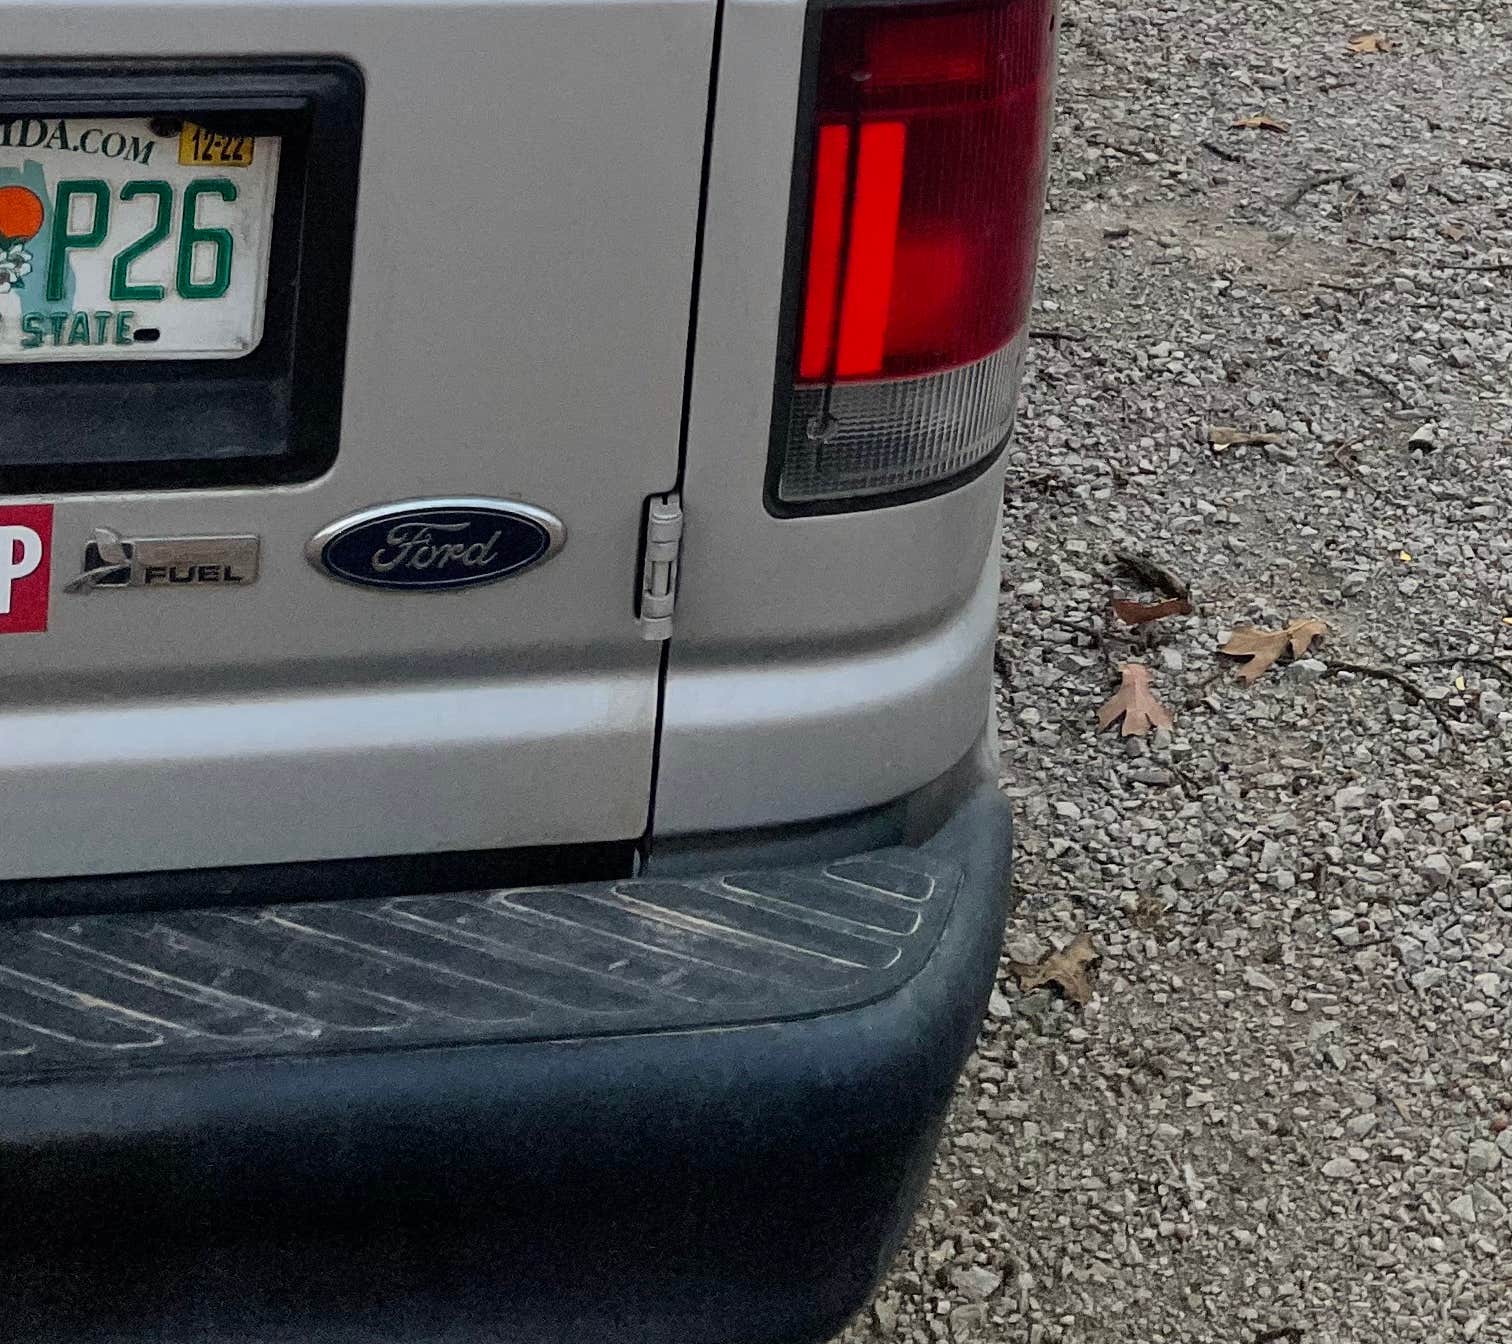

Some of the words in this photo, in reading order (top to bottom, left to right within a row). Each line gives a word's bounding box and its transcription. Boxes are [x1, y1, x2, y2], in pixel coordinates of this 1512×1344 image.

[46, 178, 238, 302] P26
[20, 310, 134, 348] STATE
[371, 521, 503, 572] Ford
[144, 564, 243, 585] FUEL
